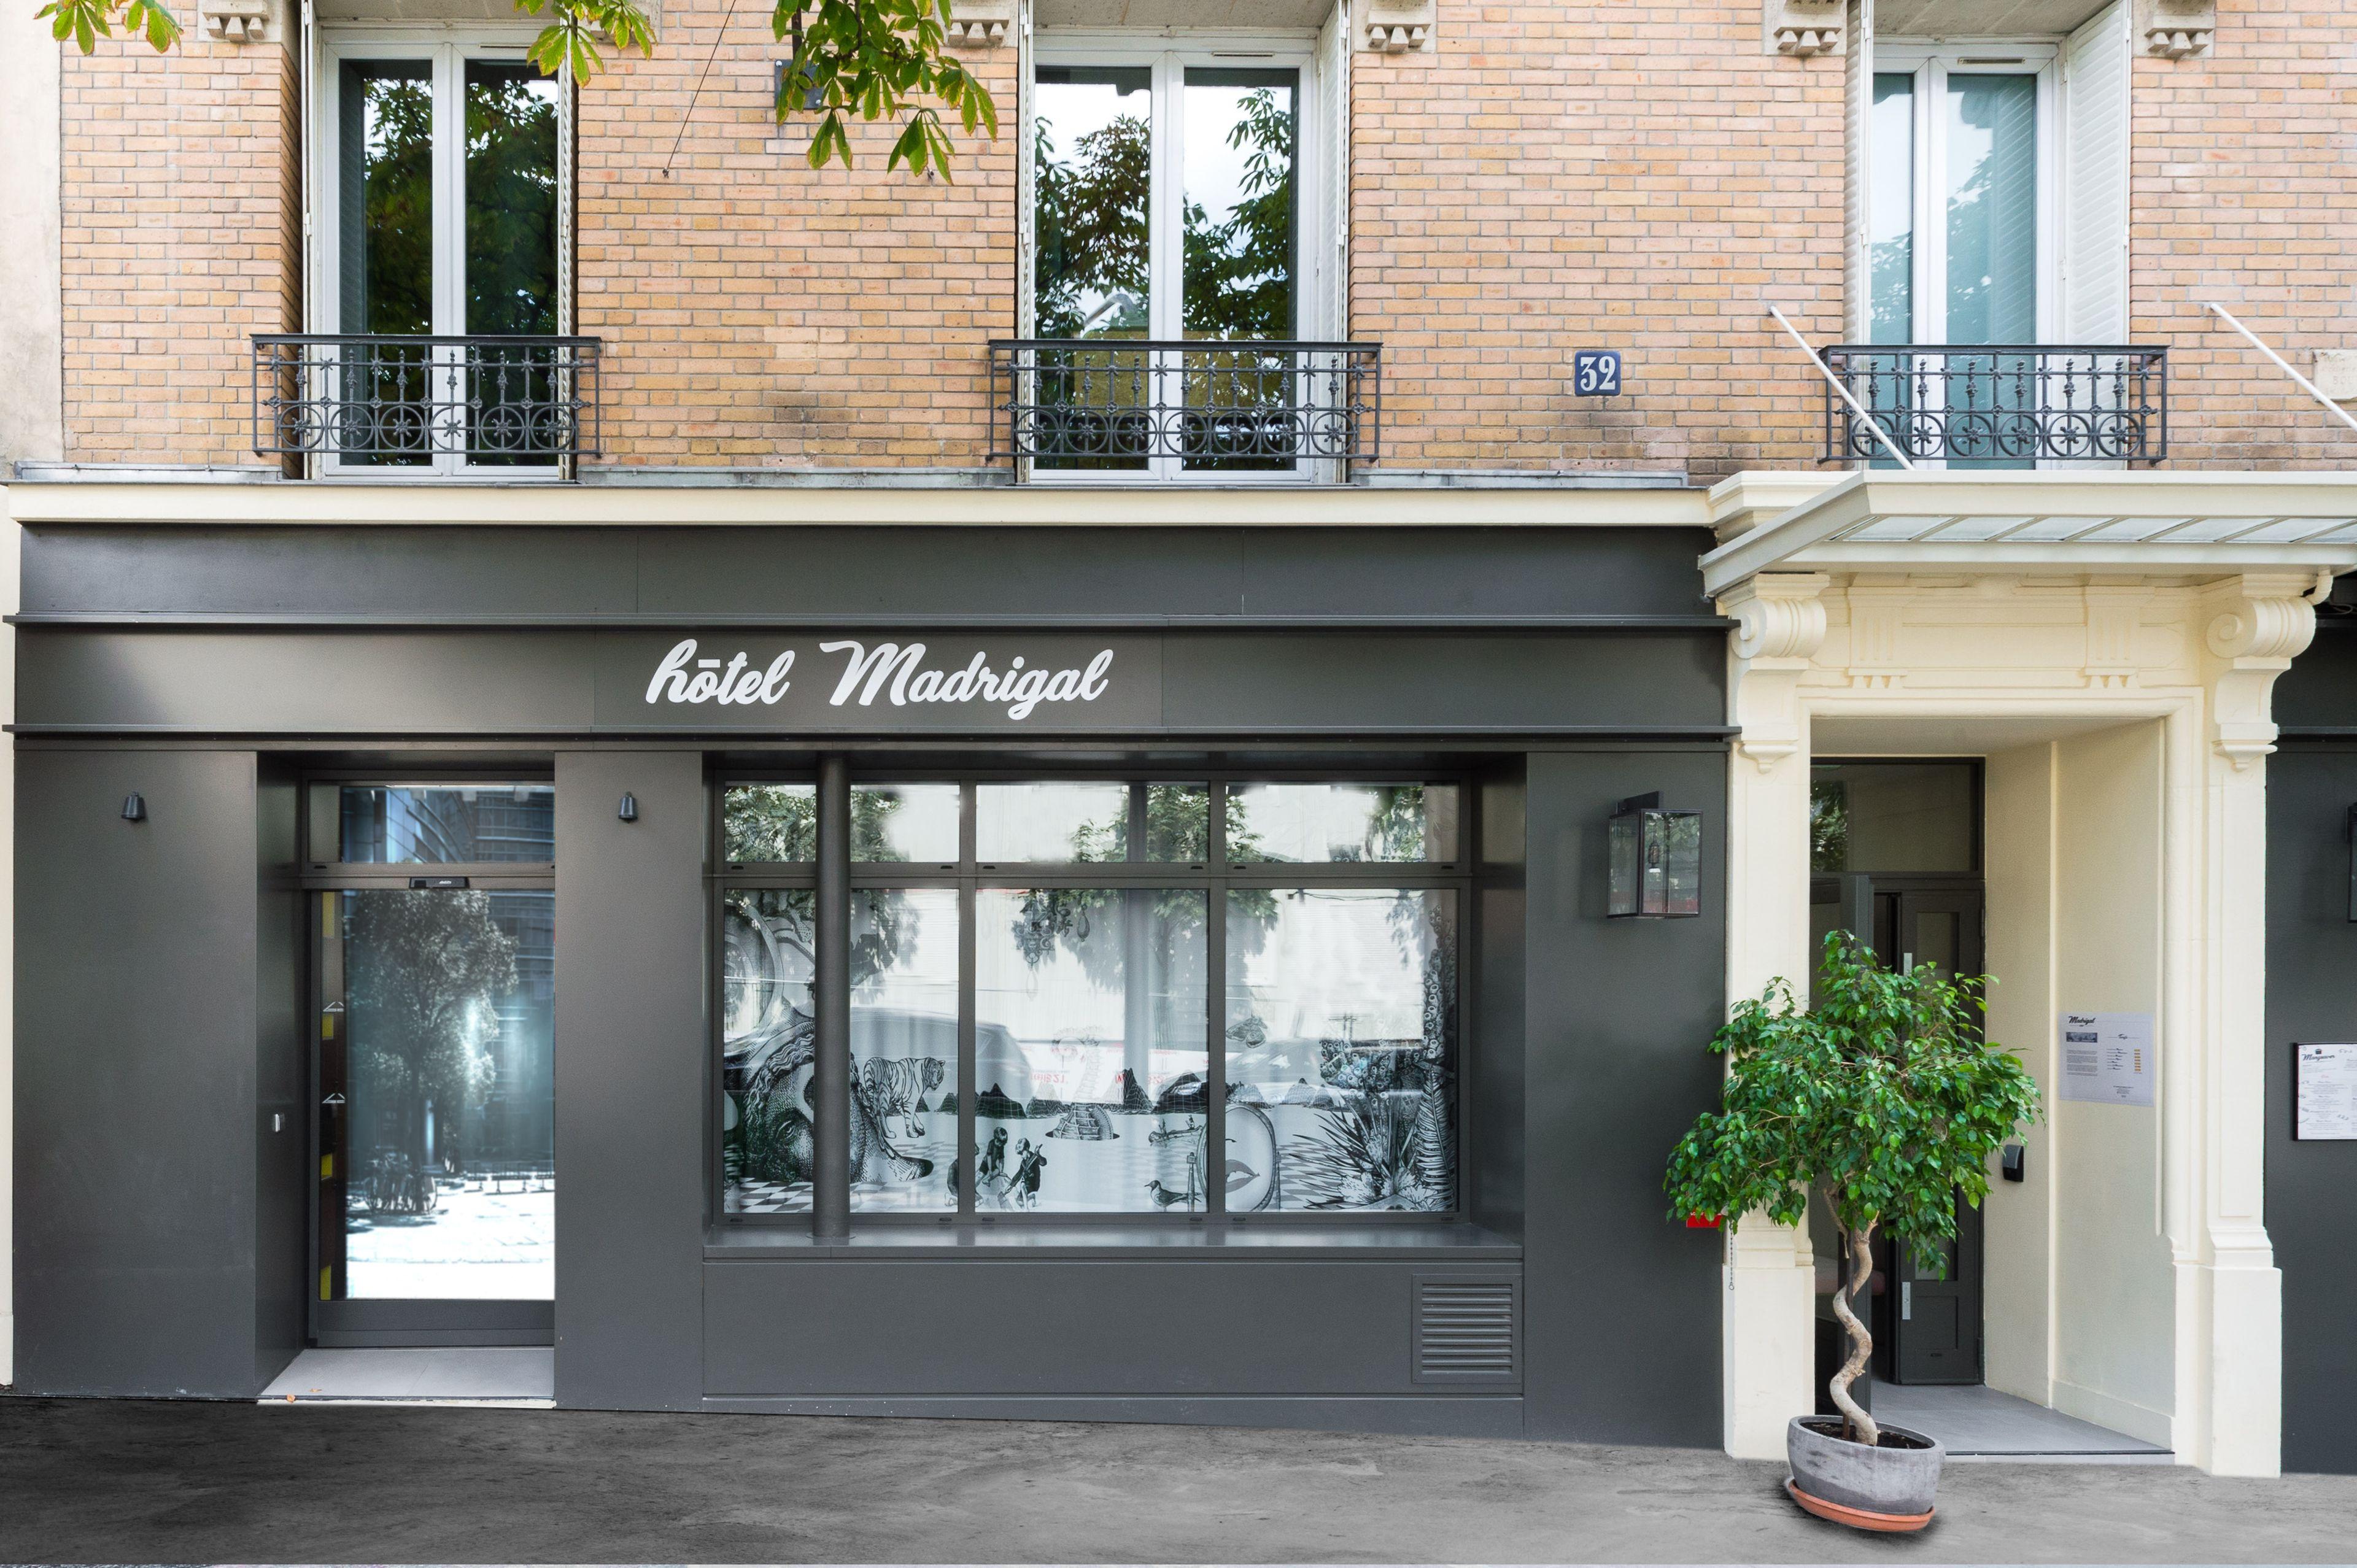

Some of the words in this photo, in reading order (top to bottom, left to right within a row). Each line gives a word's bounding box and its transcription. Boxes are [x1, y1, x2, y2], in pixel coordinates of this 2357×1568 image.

[1581, 356, 1616, 391] 32
[819, 641, 1113, 720] Madrigal
[2068, 1016, 2096, 1025] Madrigal
